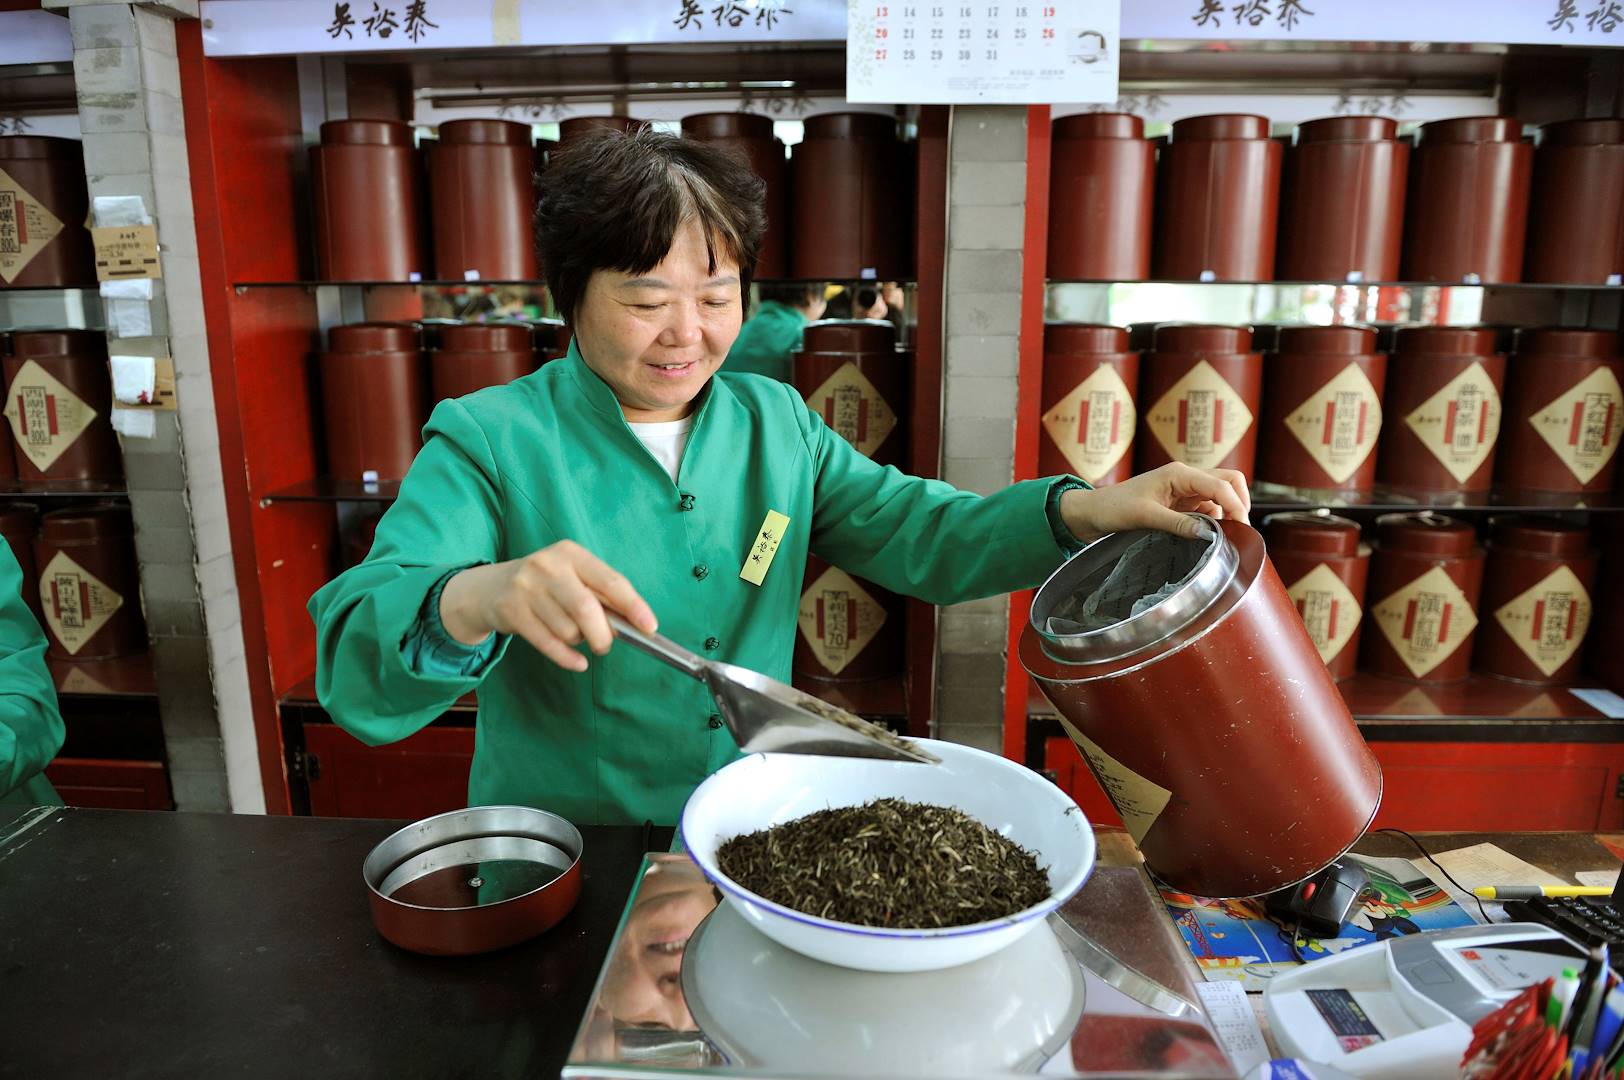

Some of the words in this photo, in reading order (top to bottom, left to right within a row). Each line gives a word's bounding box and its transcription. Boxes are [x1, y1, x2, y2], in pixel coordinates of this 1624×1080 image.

[876, 7, 888, 18] 13
[904, 7, 916, 18] 14
[932, 7, 944, 18] 15
[960, 7, 971, 18] 16
[987, 7, 999, 18] 17
[1015, 7, 1027, 18] 18
[1043, 7, 1055, 18] 19
[875, 28, 888, 39] 20
[903, 28, 916, 39] 21
[931, 28, 944, 39] 22
[959, 28, 971, 39] 23
[986, 28, 999, 39] 24
[1014, 28, 1027, 39] 25
[1042, 28, 1055, 39] 26
[875, 49, 888, 60] 27
[903, 49, 916, 60] 28
[931, 49, 944, 60] 29
[959, 49, 971, 60] 30
[986, 49, 999, 60] 31
